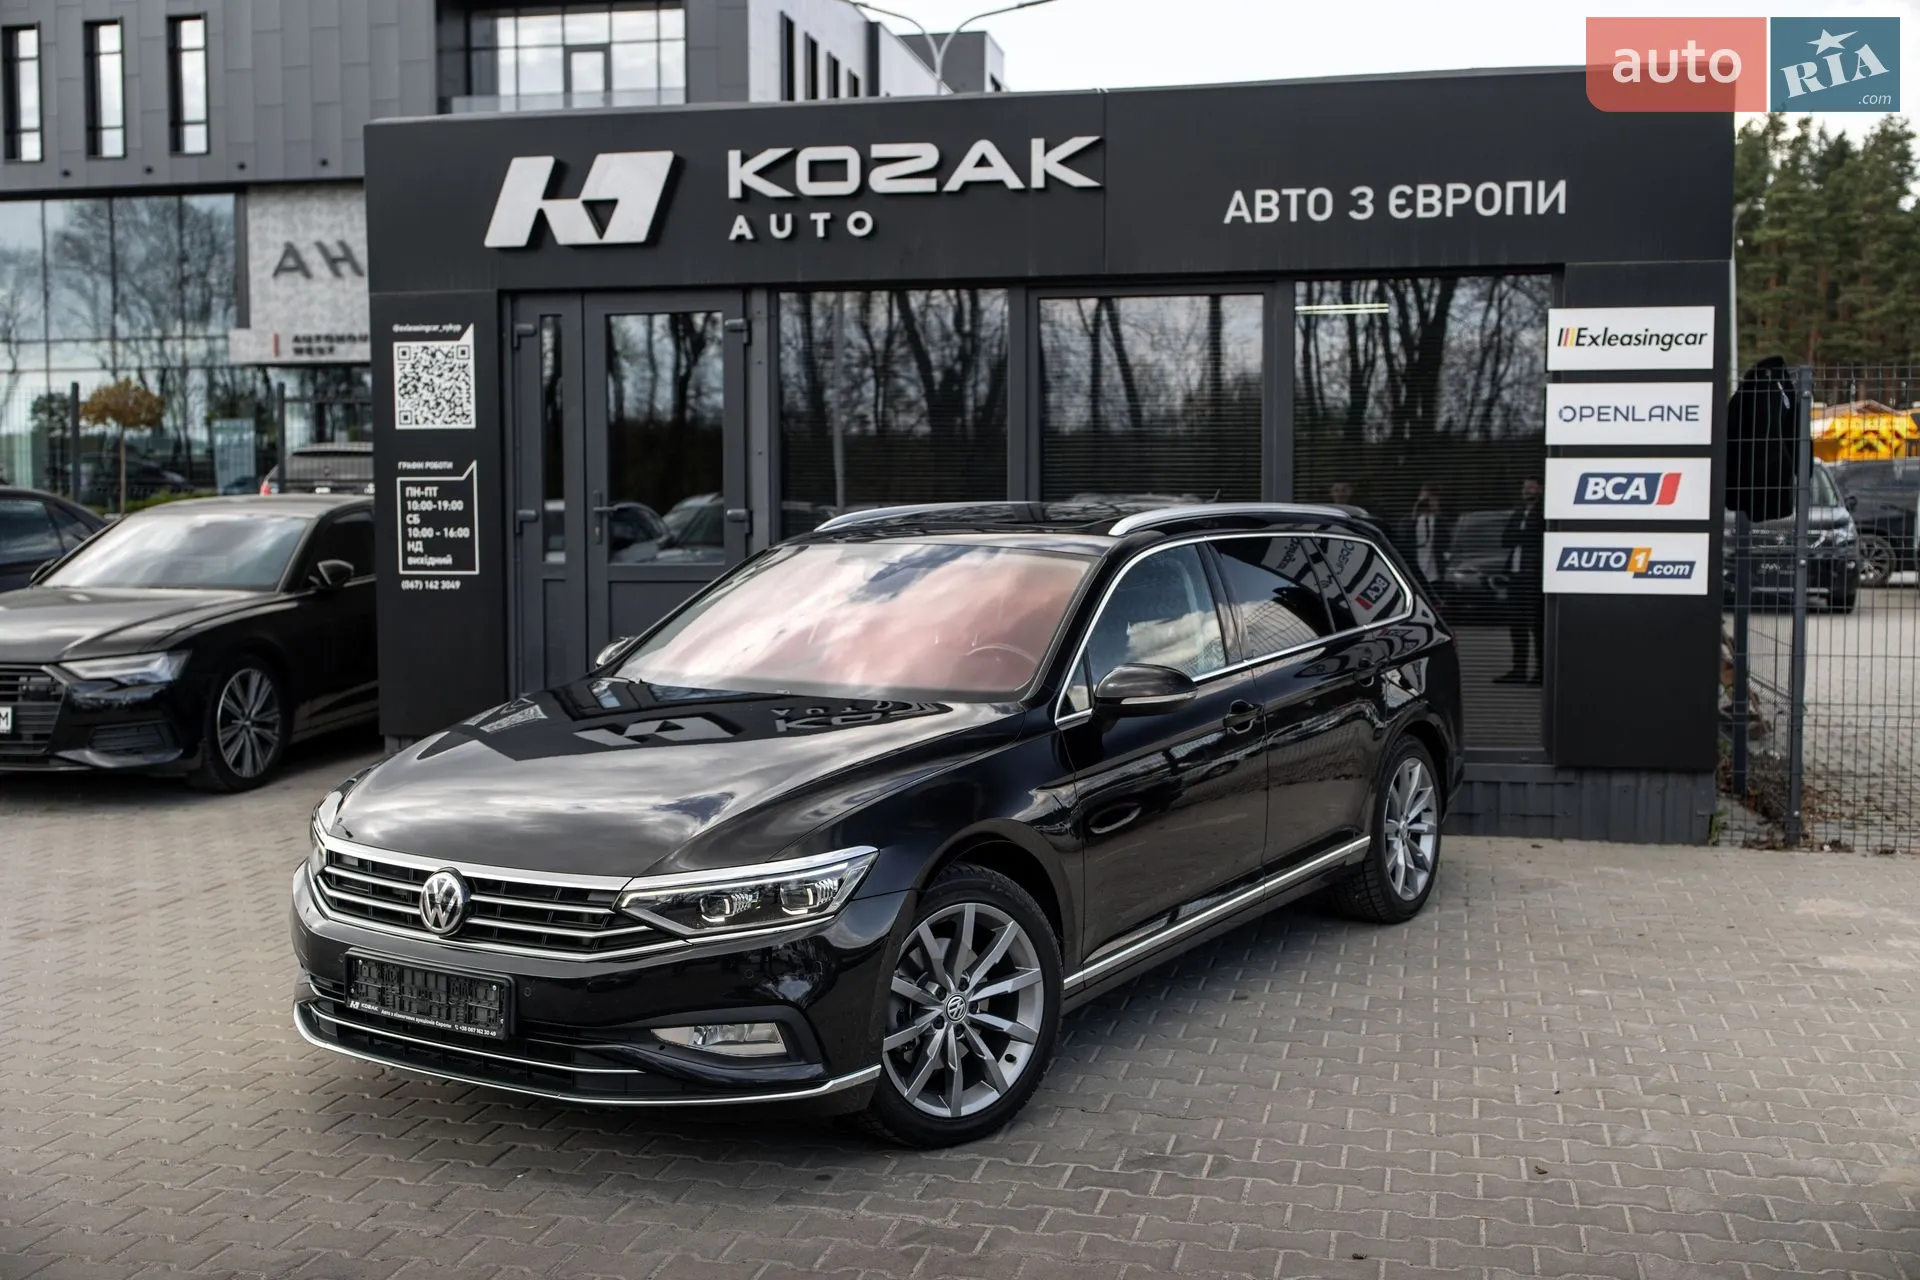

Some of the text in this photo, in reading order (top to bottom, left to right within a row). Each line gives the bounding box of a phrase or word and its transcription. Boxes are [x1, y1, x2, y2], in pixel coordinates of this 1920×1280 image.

[727, 136, 1102, 198] KOZAK
[1223, 187, 1334, 224] АВТО
[1388, 180, 1567, 220] ЄВРОПИ
[729, 211, 874, 241] AUTO
[1575, 327, 1708, 351] Exleasingcar
[1559, 405, 1699, 422] OPENLANE
[406, 487, 439, 497] ПН-ПТ
[1584, 477, 1647, 501] BCA
[407, 500, 464, 511] 10:00-19:00
[406, 514, 421, 525] СБ
[408, 528, 434, 538] 10:00
[444, 527, 470, 538] 16:00
[407, 541, 424, 552] НД
[1563, 550, 1690, 576] AUTO1.com
[401, 580, 461, 590] (067) 162 3049
